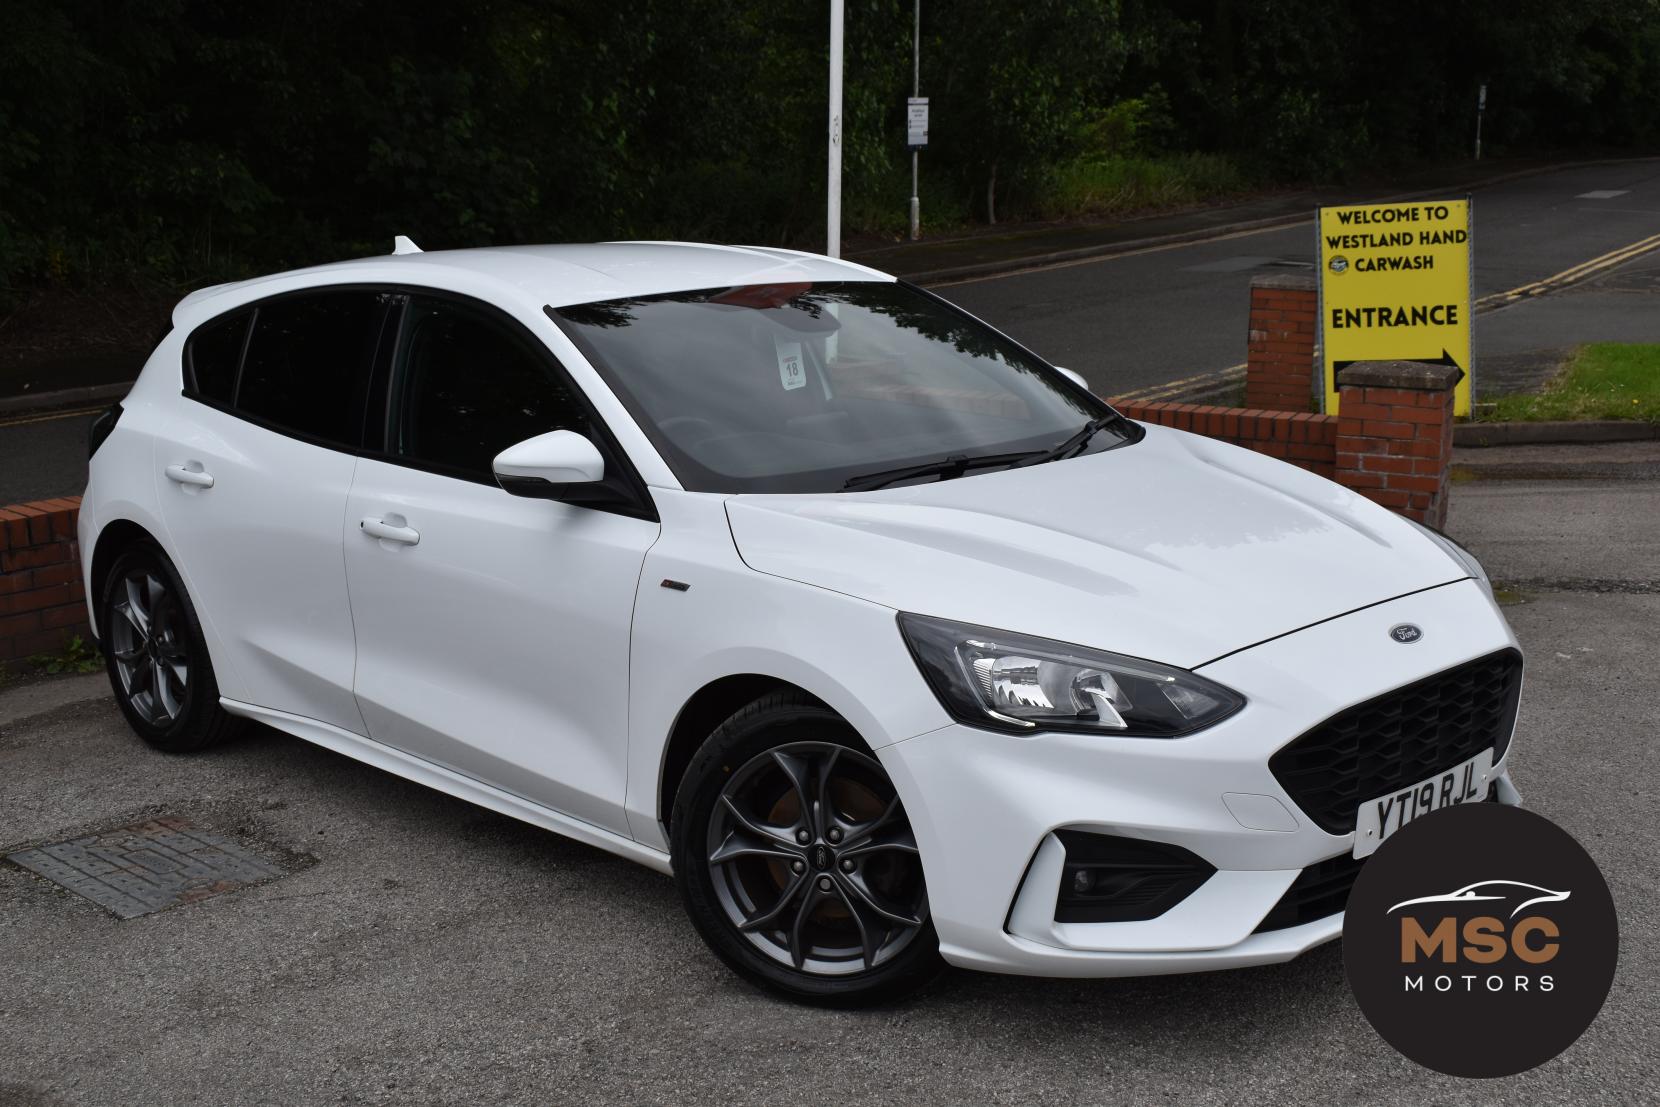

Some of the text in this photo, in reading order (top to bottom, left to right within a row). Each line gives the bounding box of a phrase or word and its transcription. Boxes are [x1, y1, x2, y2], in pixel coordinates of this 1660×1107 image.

[1337, 206, 1449, 225] WELCOME TO
[1326, 230, 1467, 249] WESTLAND HAND
[1355, 255, 1434, 272] CARWASH
[1332, 305, 1458, 329] ENTRANCE
[786, 362, 799, 378] 18
[1377, 762, 1478, 840] YT19 RJL
